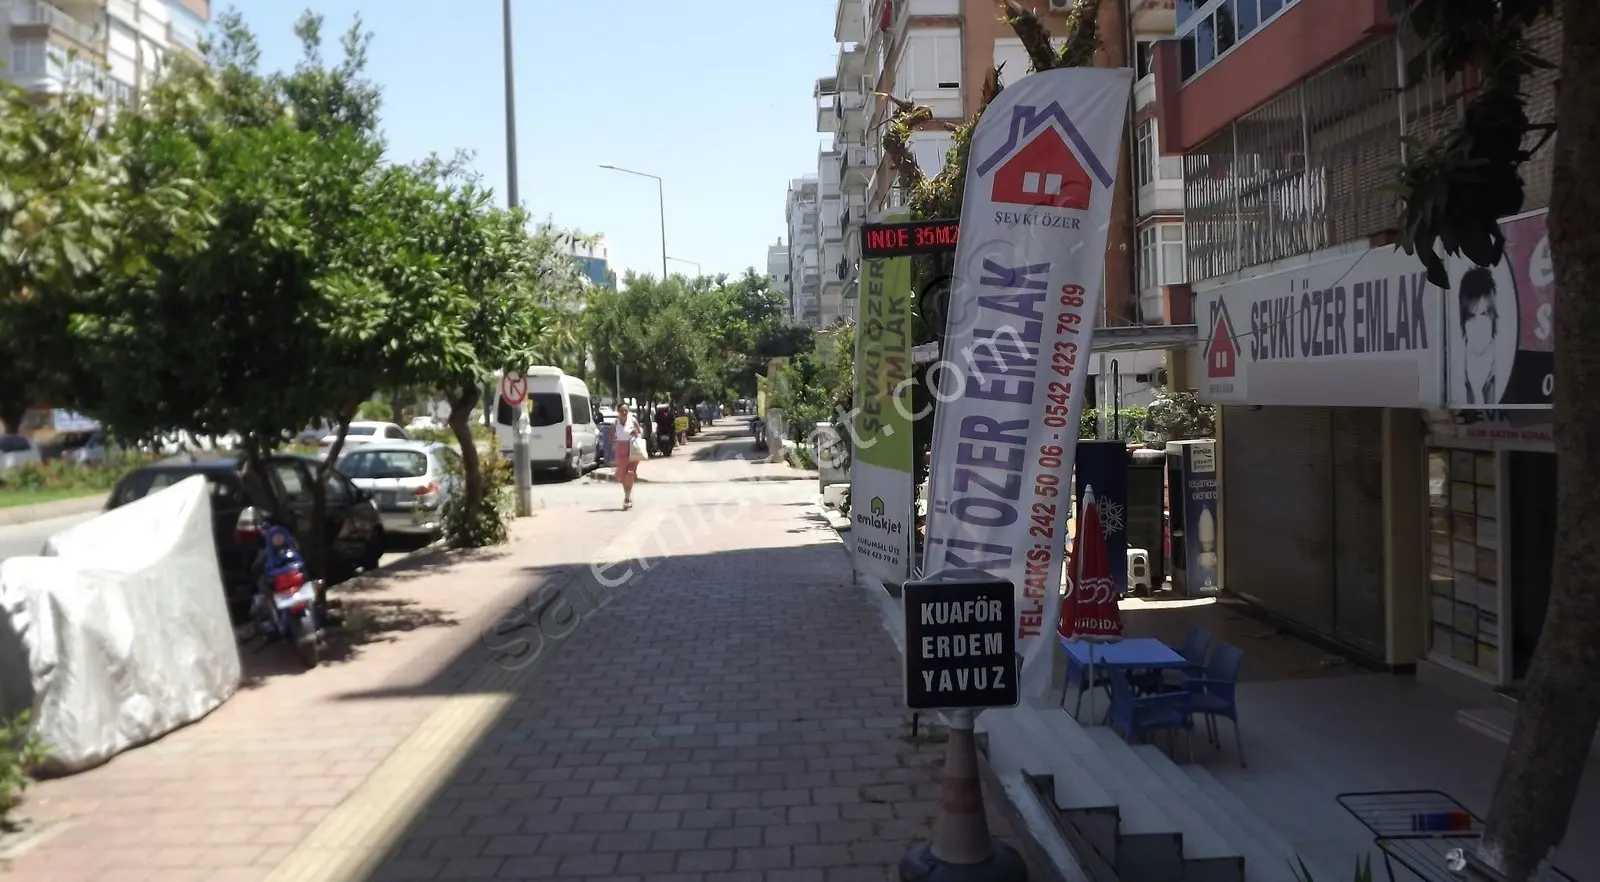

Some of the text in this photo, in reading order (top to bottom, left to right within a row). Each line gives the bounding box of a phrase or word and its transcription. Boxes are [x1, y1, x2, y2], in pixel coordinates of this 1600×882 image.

[994, 209, 1081, 230] ŞEVKİ ÖZER
[864, 259, 885, 341] ÖZER
[1060, 283, 1086, 307] 89
[963, 257, 1051, 404] EMLAK
[1056, 311, 1083, 336] 79
[1300, 278, 1348, 358] ÖZER
[1353, 271, 1429, 354] EMLAK
[884, 296, 907, 398] EMLAK
[1051, 338, 1079, 379] 423
[1044, 381, 1072, 429] 0542
[936, 415, 1030, 527] ÖZER
[1039, 445, 1064, 471] 06
[1033, 474, 1061, 500] 50
[857, 513, 901, 535] emlakjet
[1030, 503, 1057, 538] 242
[1018, 537, 1052, 639] TEL-FAKS:
[920, 595, 1002, 626] KUAFÖR
[921, 632, 1003, 660] ERDEM
[921, 666, 1006, 693] YAVUZ
